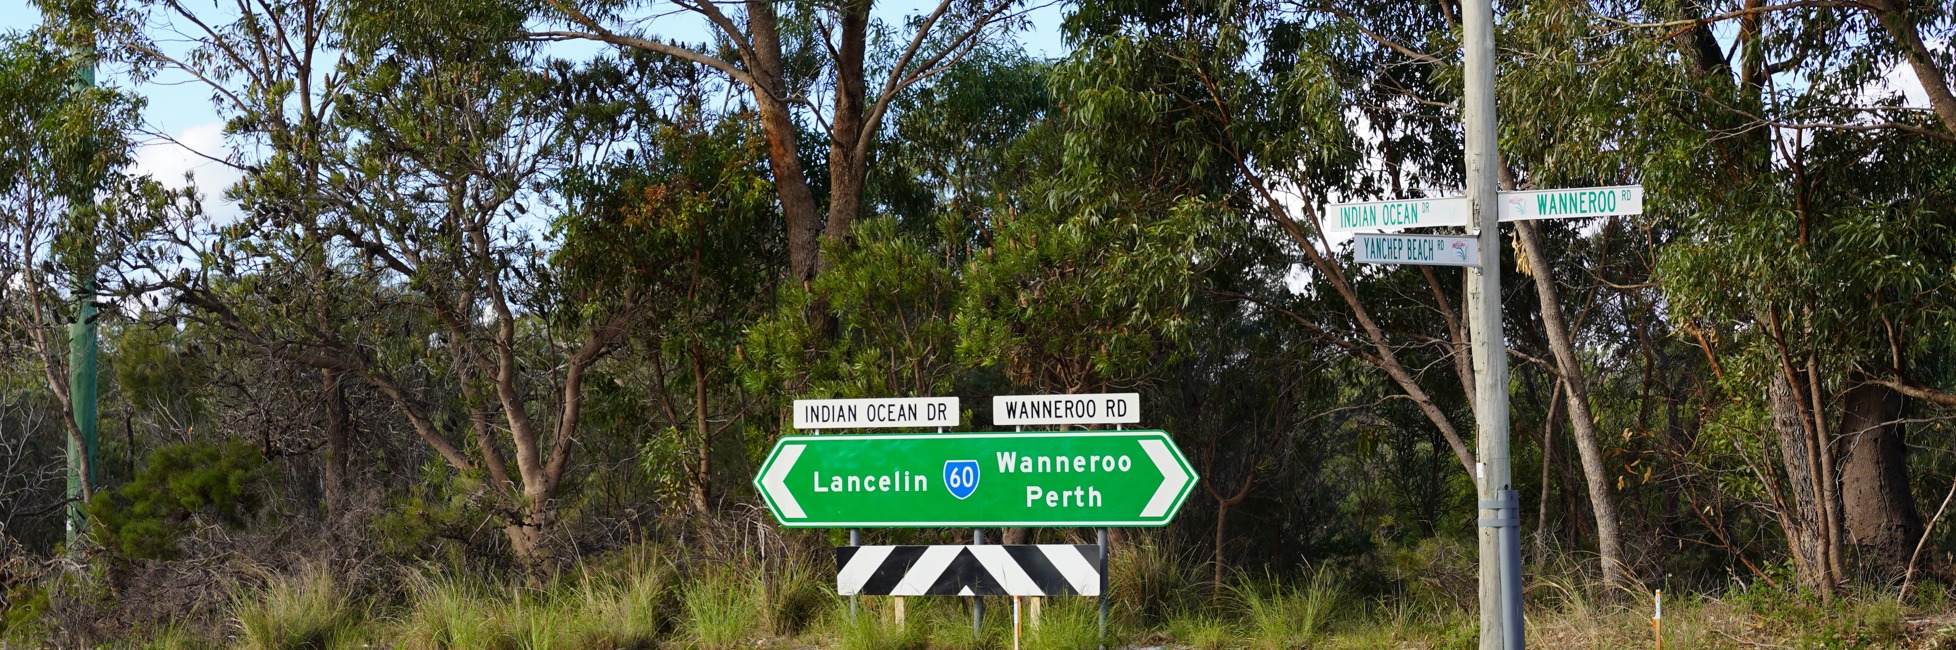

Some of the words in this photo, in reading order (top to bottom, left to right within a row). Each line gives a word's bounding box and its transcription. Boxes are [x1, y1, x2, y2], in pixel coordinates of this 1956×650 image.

[1537, 190, 1616, 215] WANNEROO
[1622, 190, 1631, 201] RD
[1340, 206, 1376, 228] INDIAN
[1383, 203, 1418, 225] OCEAN
[1422, 202, 1429, 213] DR
[1364, 237, 1403, 260] YANCHEP
[1407, 238, 1434, 261] BEACH
[1437, 240, 1444, 250] RD
[805, 404, 857, 422] INDIAN
[867, 403, 920, 422] OCEAN
[927, 402, 948, 421] DR
[1005, 400, 1096, 419] WANNEROO
[1105, 399, 1127, 417] RD
[996, 451, 1132, 473] Wanneroo
[813, 471, 928, 493] Lancelin
[949, 466, 973, 488] 60
[1026, 485, 1102, 508] Perth
